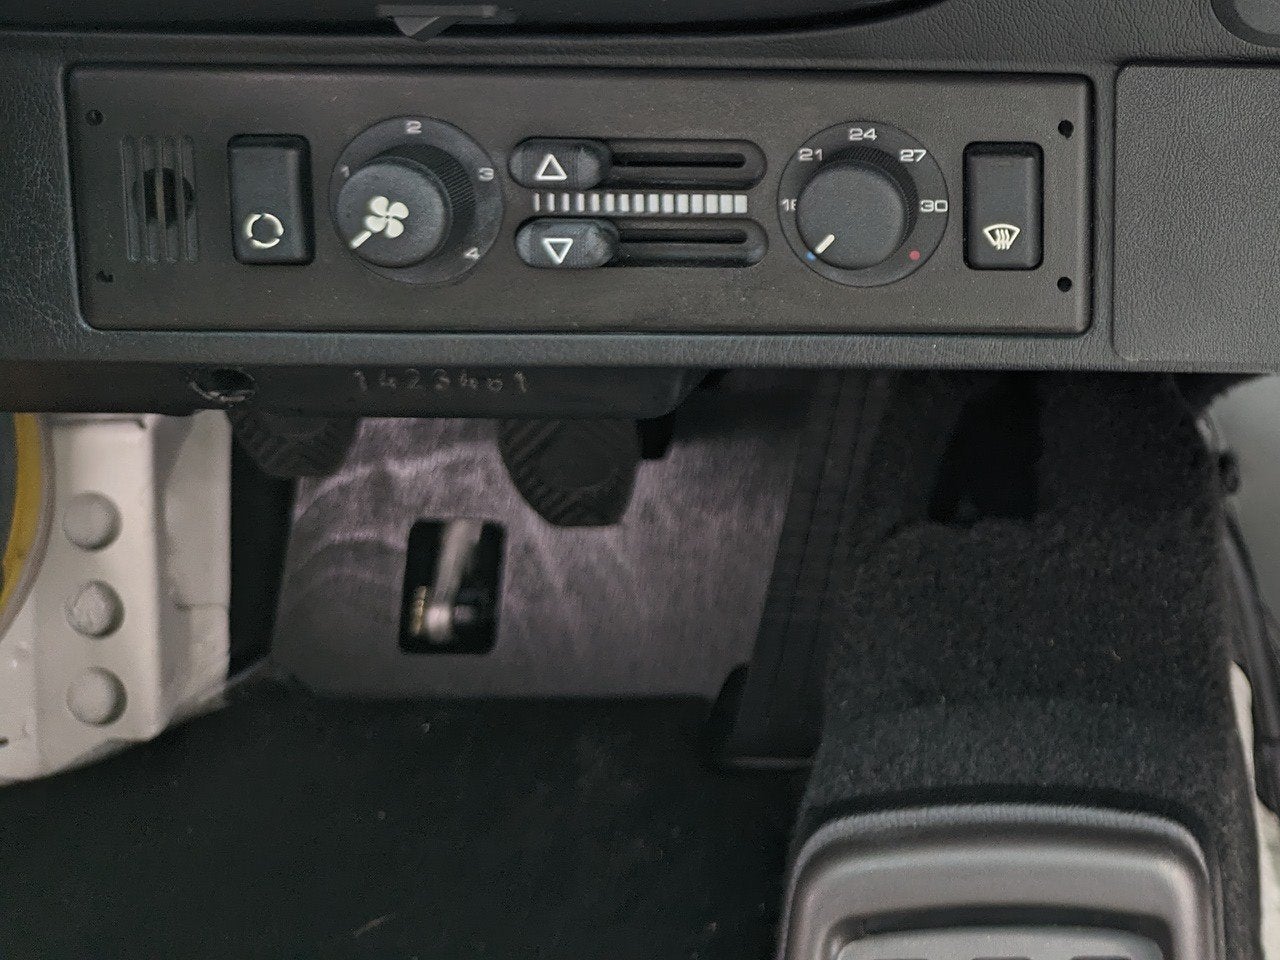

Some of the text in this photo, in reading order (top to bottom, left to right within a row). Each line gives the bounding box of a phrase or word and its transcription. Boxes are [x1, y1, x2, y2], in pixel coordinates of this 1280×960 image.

[406, 120, 423, 135] 2
[849, 128, 878, 141] 24
[799, 148, 823, 162] 21
[900, 149, 927, 162] 27
[478, 167, 496, 182] 3
[919, 199, 949, 213] 30
[464, 247, 481, 261] 4
